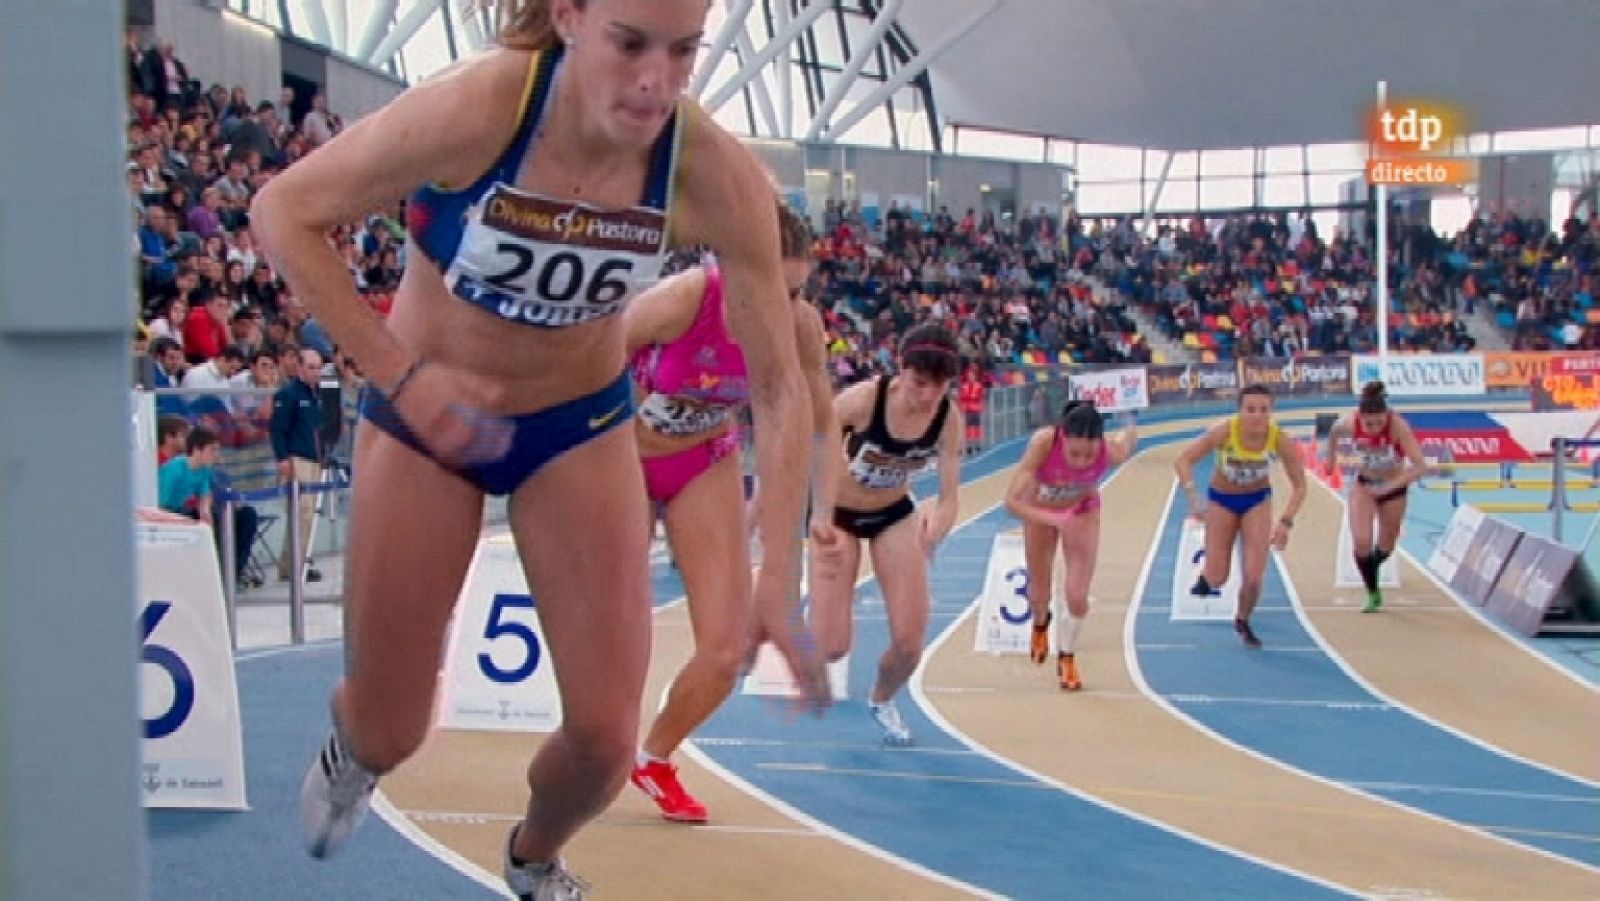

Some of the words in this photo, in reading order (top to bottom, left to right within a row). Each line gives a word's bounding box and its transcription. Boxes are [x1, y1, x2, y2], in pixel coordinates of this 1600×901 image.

[482, 243, 634, 304] 206
[1000, 567, 1032, 625] 3
[138, 600, 195, 739] 6
[477, 593, 541, 683] 5
